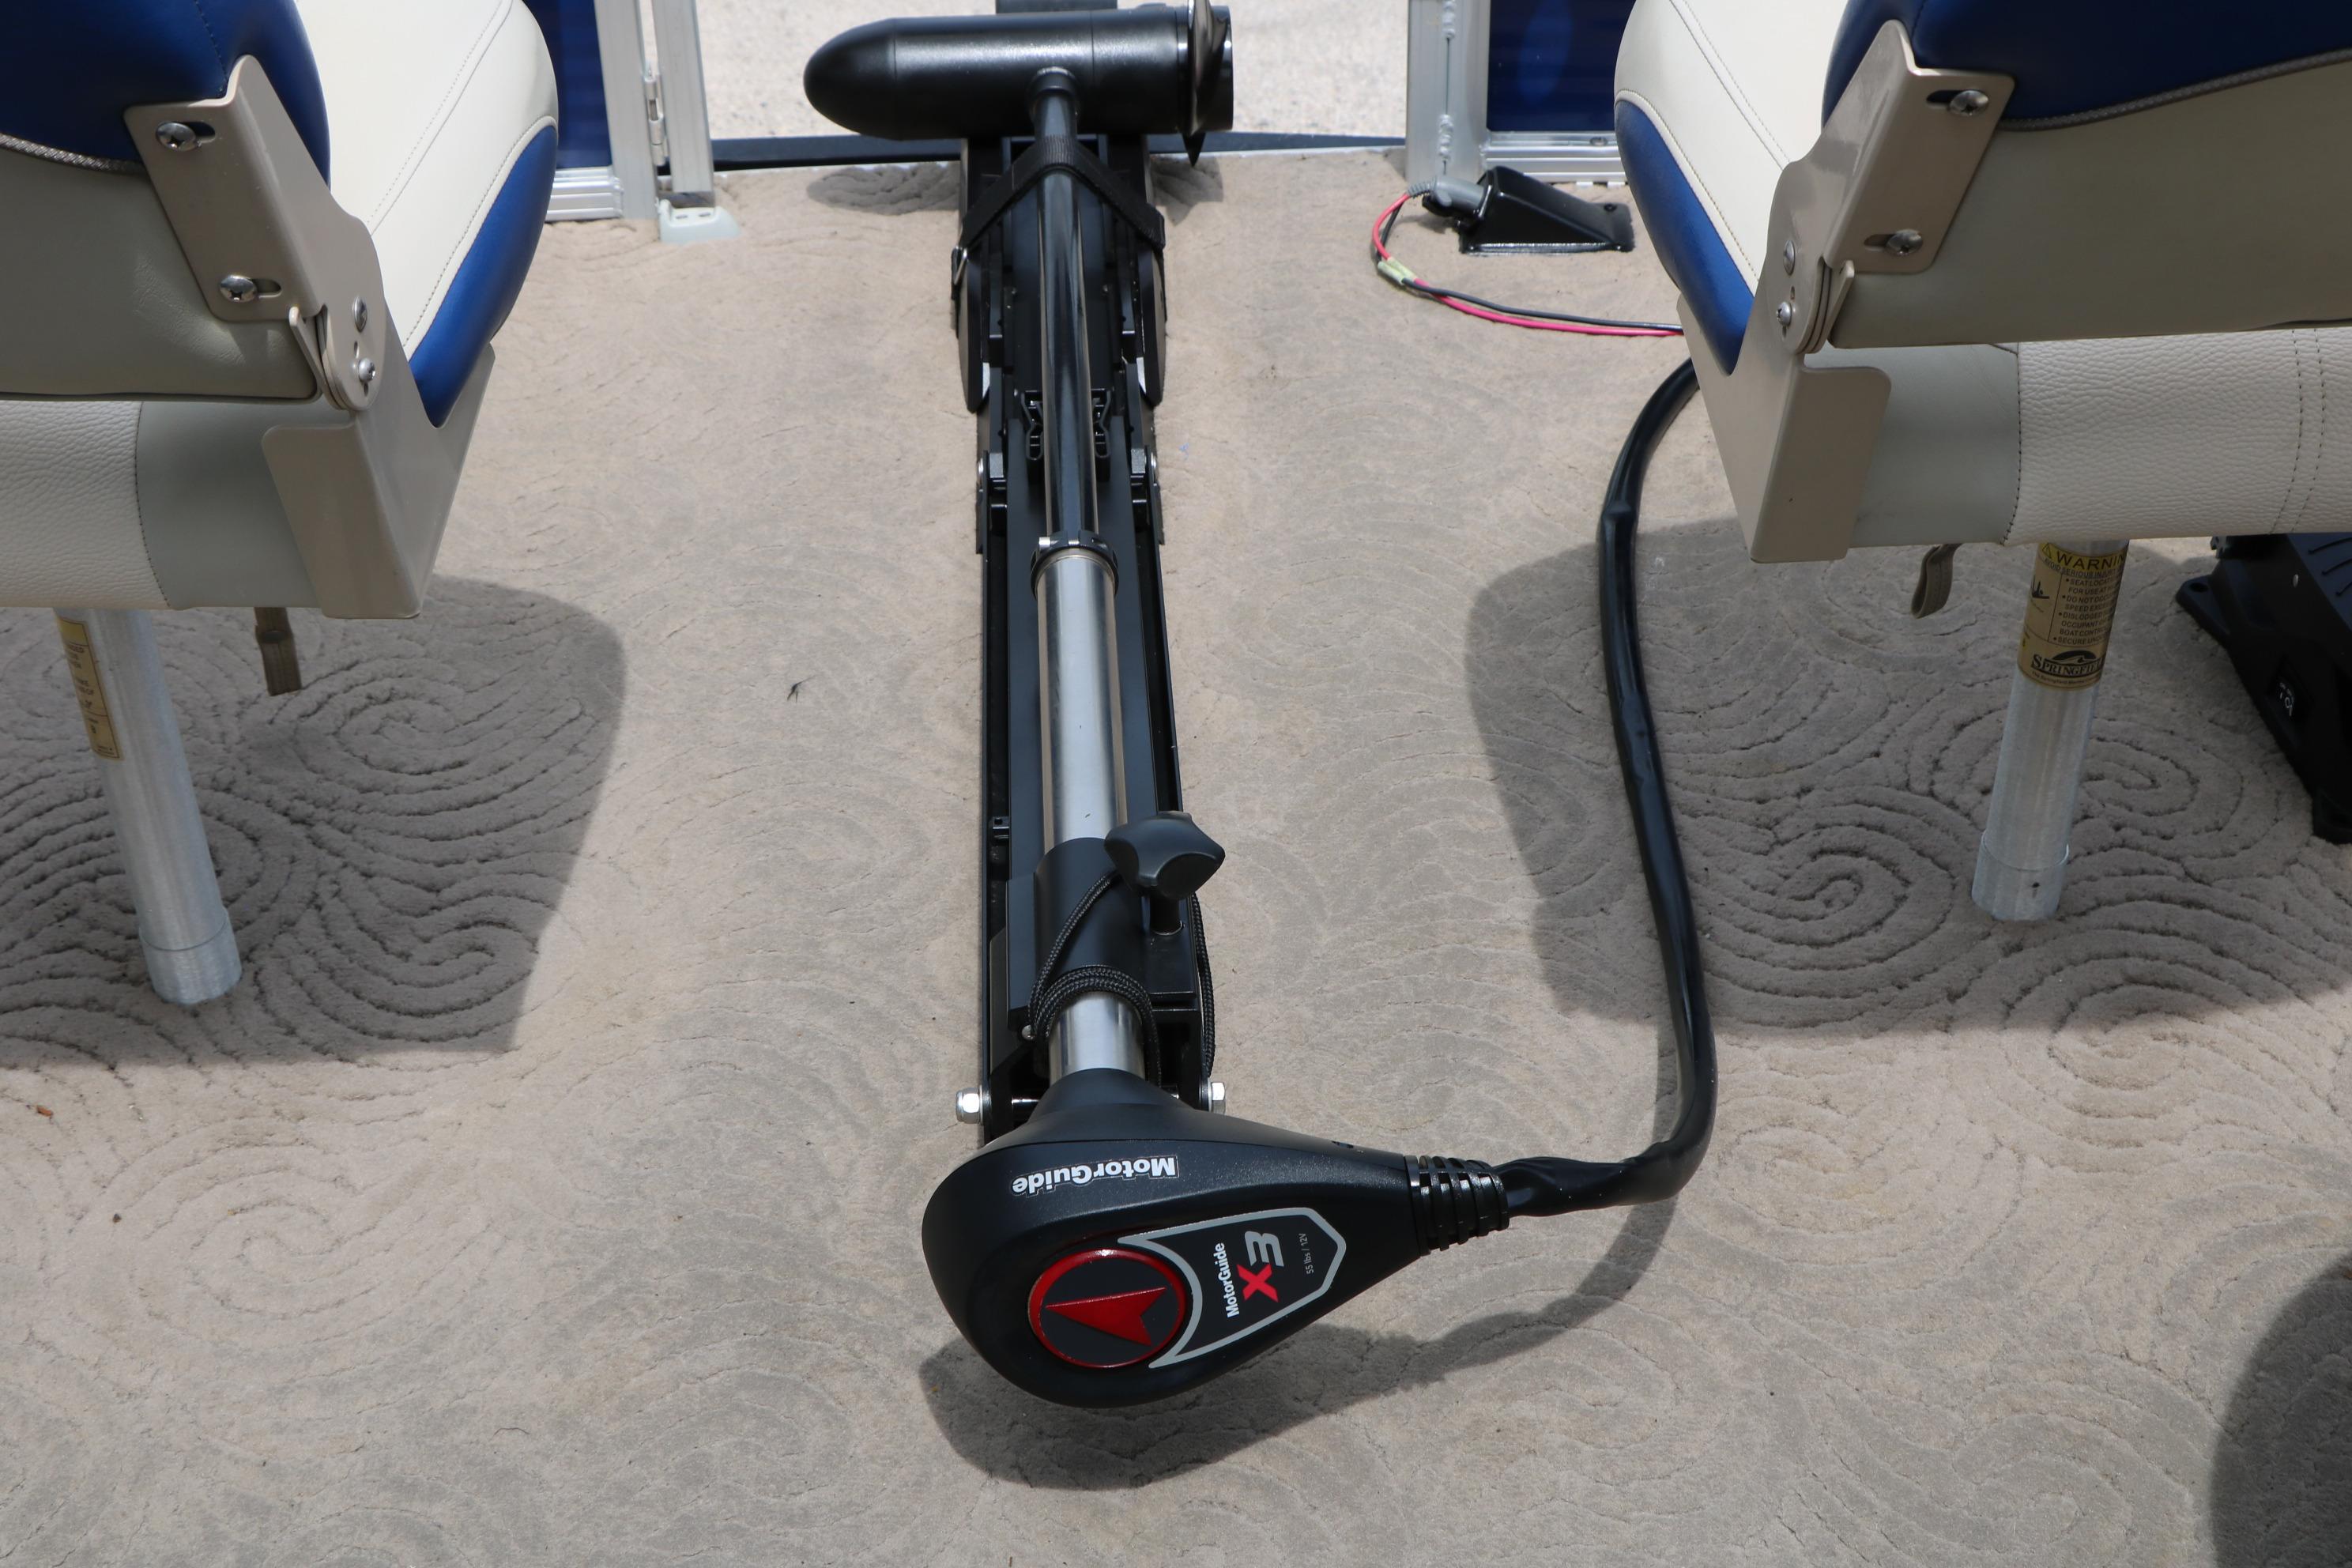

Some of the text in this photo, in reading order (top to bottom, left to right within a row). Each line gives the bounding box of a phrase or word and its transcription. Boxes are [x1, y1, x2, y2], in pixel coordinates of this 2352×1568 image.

[2056, 551, 2124, 571] WARNIN
[2068, 586, 2084, 595] FOR
[2064, 603, 2089, 612] SPEED
[2057, 636, 2086, 645] SECURE
[2031, 654, 2103, 676] SPRINGFIEL
[1012, 1156, 1177, 1195] MotorGuide
[1298, 1232, 1310, 1247] 12V
[1302, 1252, 1314, 1265] lbs
[1235, 1230, 1285, 1303] X3
[1304, 1265, 1315, 1275] 55
[1213, 1242, 1240, 1319] MotorGuide
